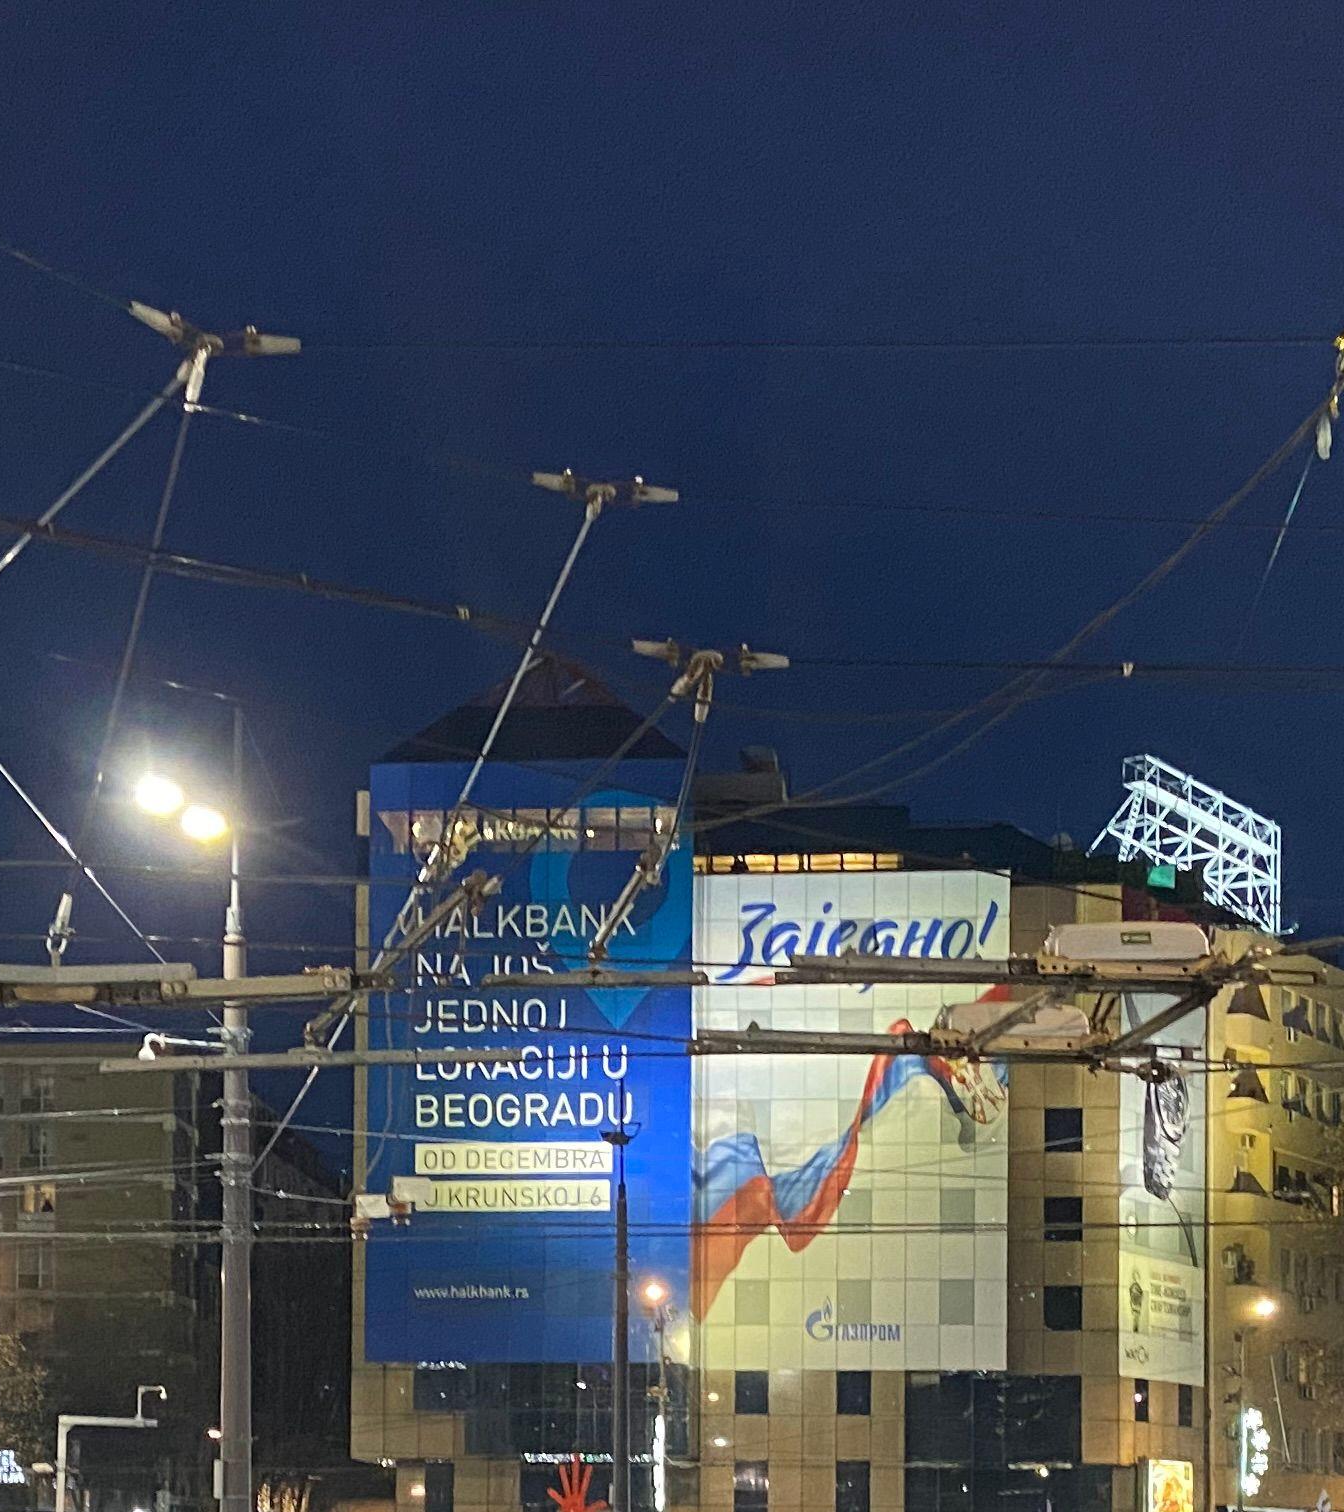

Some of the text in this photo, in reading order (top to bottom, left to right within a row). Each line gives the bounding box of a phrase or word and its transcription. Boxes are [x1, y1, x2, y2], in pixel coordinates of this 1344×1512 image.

[417, 903, 636, 940] HALKBANK
[416, 952, 471, 987] NA
[414, 998, 567, 1034] JEDNOJ
[602, 1044, 628, 1080] U
[414, 1092, 633, 1128] BEOGRADU
[422, 1148, 606, 1170] OD DECEMBRA
[448, 1186, 583, 1209] KRUNSKOJ
[589, 1186, 602, 1207] 6
[835, 1323, 901, 1341] ГАЗПРОМ
